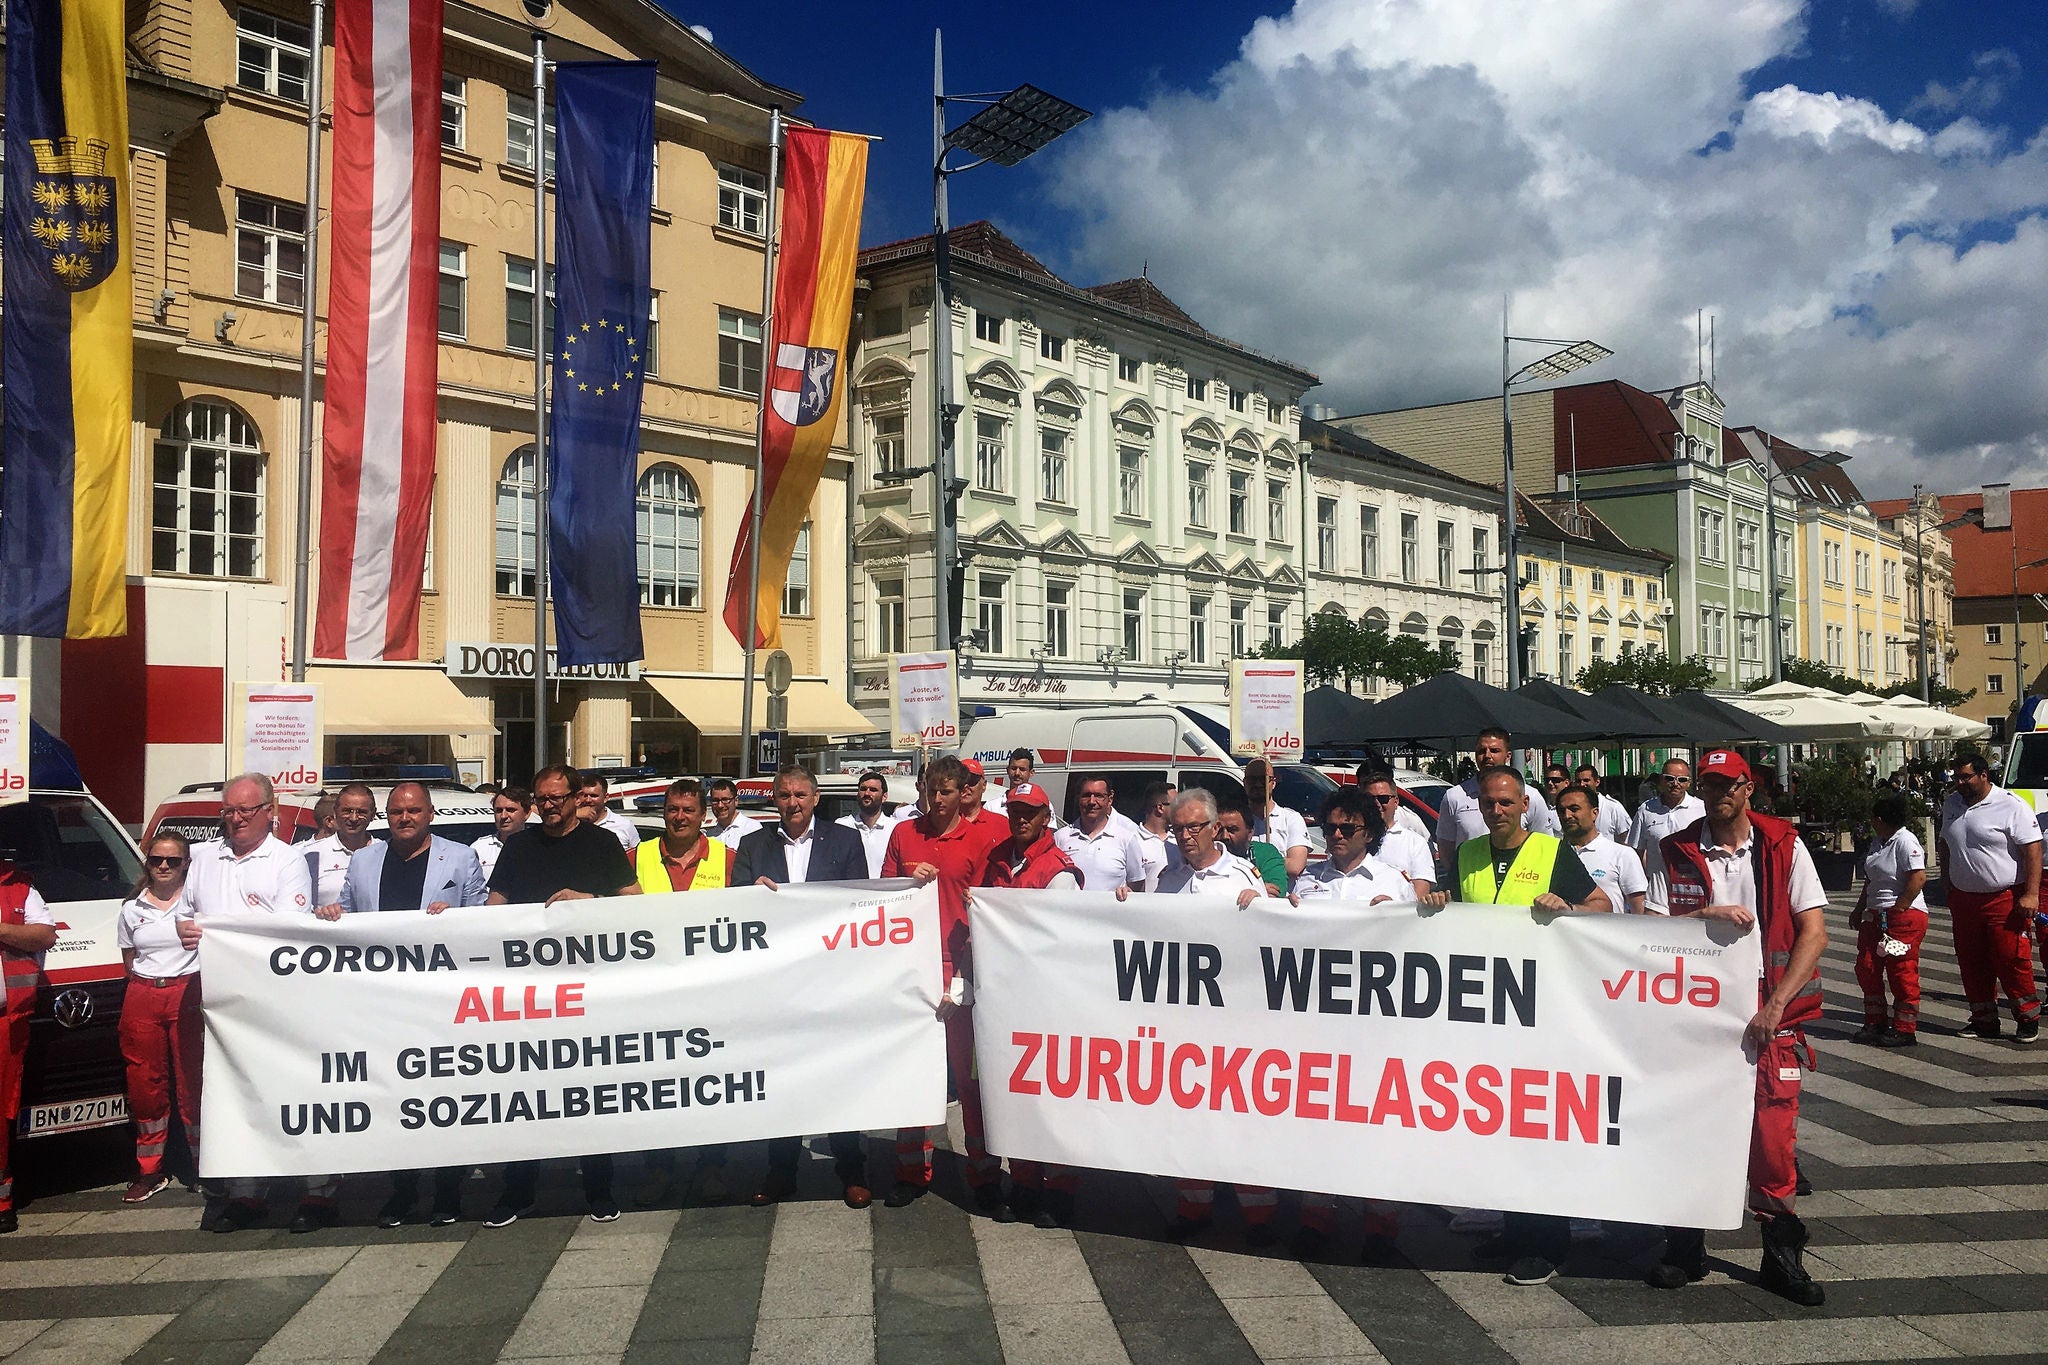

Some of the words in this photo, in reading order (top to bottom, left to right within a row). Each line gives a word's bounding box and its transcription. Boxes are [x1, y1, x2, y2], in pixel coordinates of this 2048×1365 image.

[982, 673, 1005, 692] La
[1008, 675, 1041, 693] Dolce
[1045, 676, 1068, 693] Vita
[898, 735, 916, 744] vida
[920, 720, 956, 738] vida
[1238, 742, 1256, 750] vida
[1263, 731, 1300, 749] vida
[972, 749, 1034, 761] AMBULA
[0, 768, 25, 790] da
[271, 764, 318, 785] vida
[1515, 867, 1540, 881] vida
[858, 894, 913, 908] GEWERKSCHAFT
[822, 906, 914, 951] vida
[269, 943, 458, 976] CORONA
[503, 930, 656, 968] BONUS
[684, 917, 769, 956] FÜR
[1650, 944, 1723, 957] GEWERKSCHAFT
[1112, 939, 1225, 1008] WIR
[1259, 946, 1537, 1028] WERDEN
[1601, 956, 1720, 1008] vida
[453, 983, 585, 1024] ALLE
[321, 1051, 368, 1084] IM
[397, 1027, 725, 1080] GESUNDHEITS-
[1008, 1026, 1623, 1146] ZURÜCKGELASSEN!
[280, 1101, 372, 1136] UND
[400, 1070, 766, 1130] SOZIALBEREICH!
[35, 1107, 59, 1128] BN
[73, 1101, 107, 1122] 270
